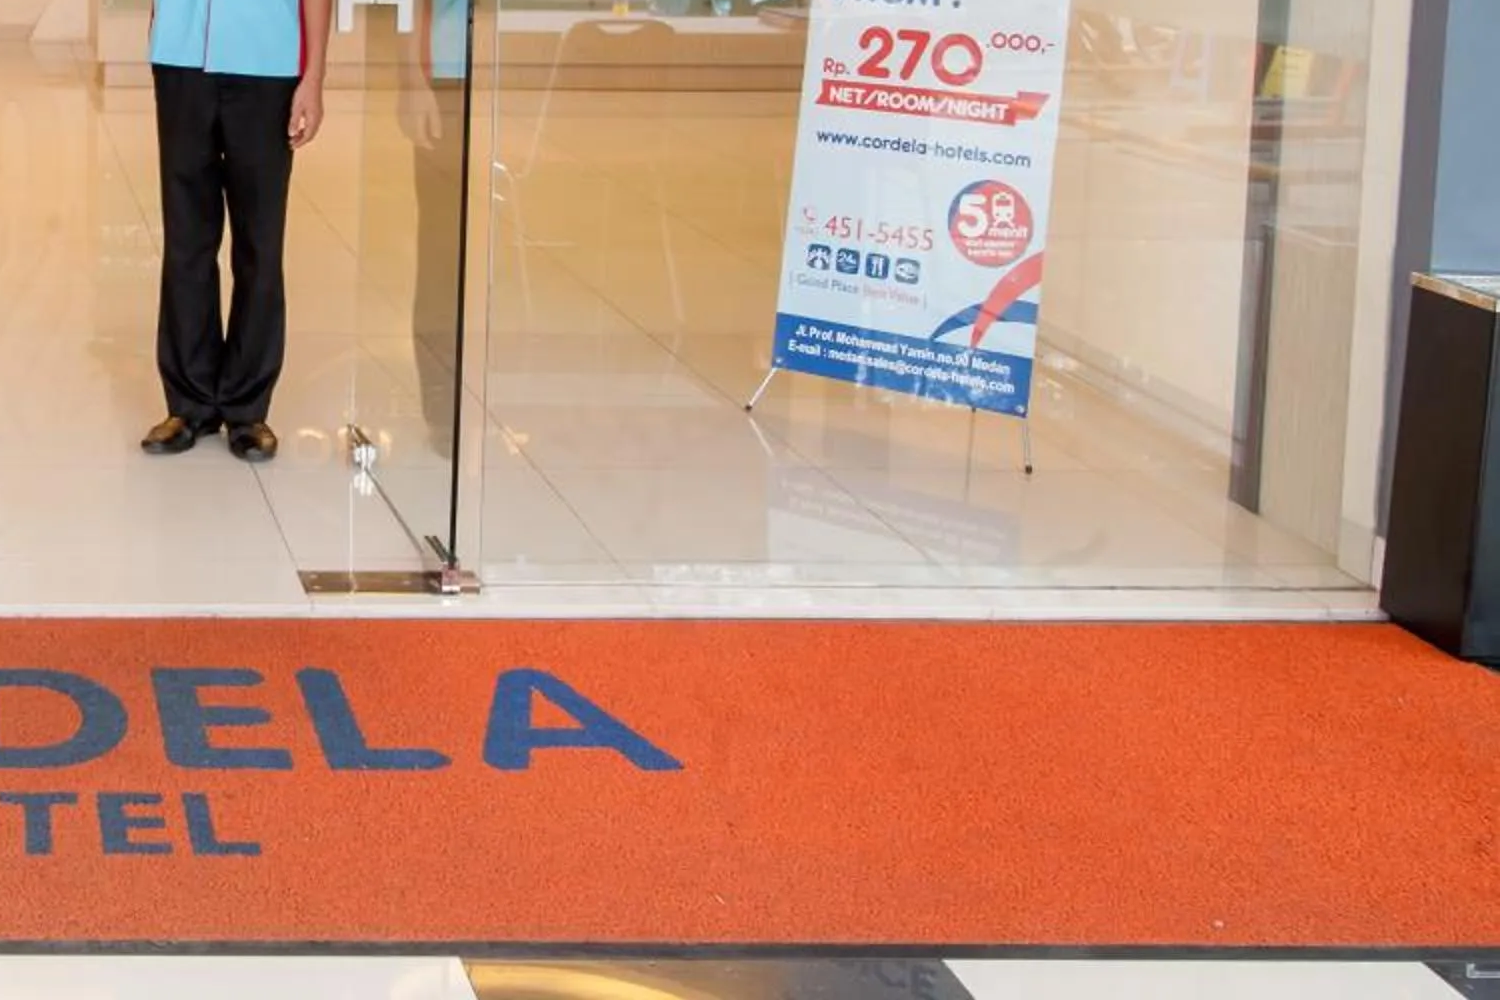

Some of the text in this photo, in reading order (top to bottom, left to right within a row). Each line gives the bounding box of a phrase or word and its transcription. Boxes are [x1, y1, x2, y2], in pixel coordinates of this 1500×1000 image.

[823, 57, 851, 76] Rp.
[829, 86, 1009, 122] NET/ROOM/NIGHT
[816, 129, 1032, 169] www.cordela-hotels.com
[824, 215, 934, 251] 451-5455
[958, 194, 988, 238] 5
